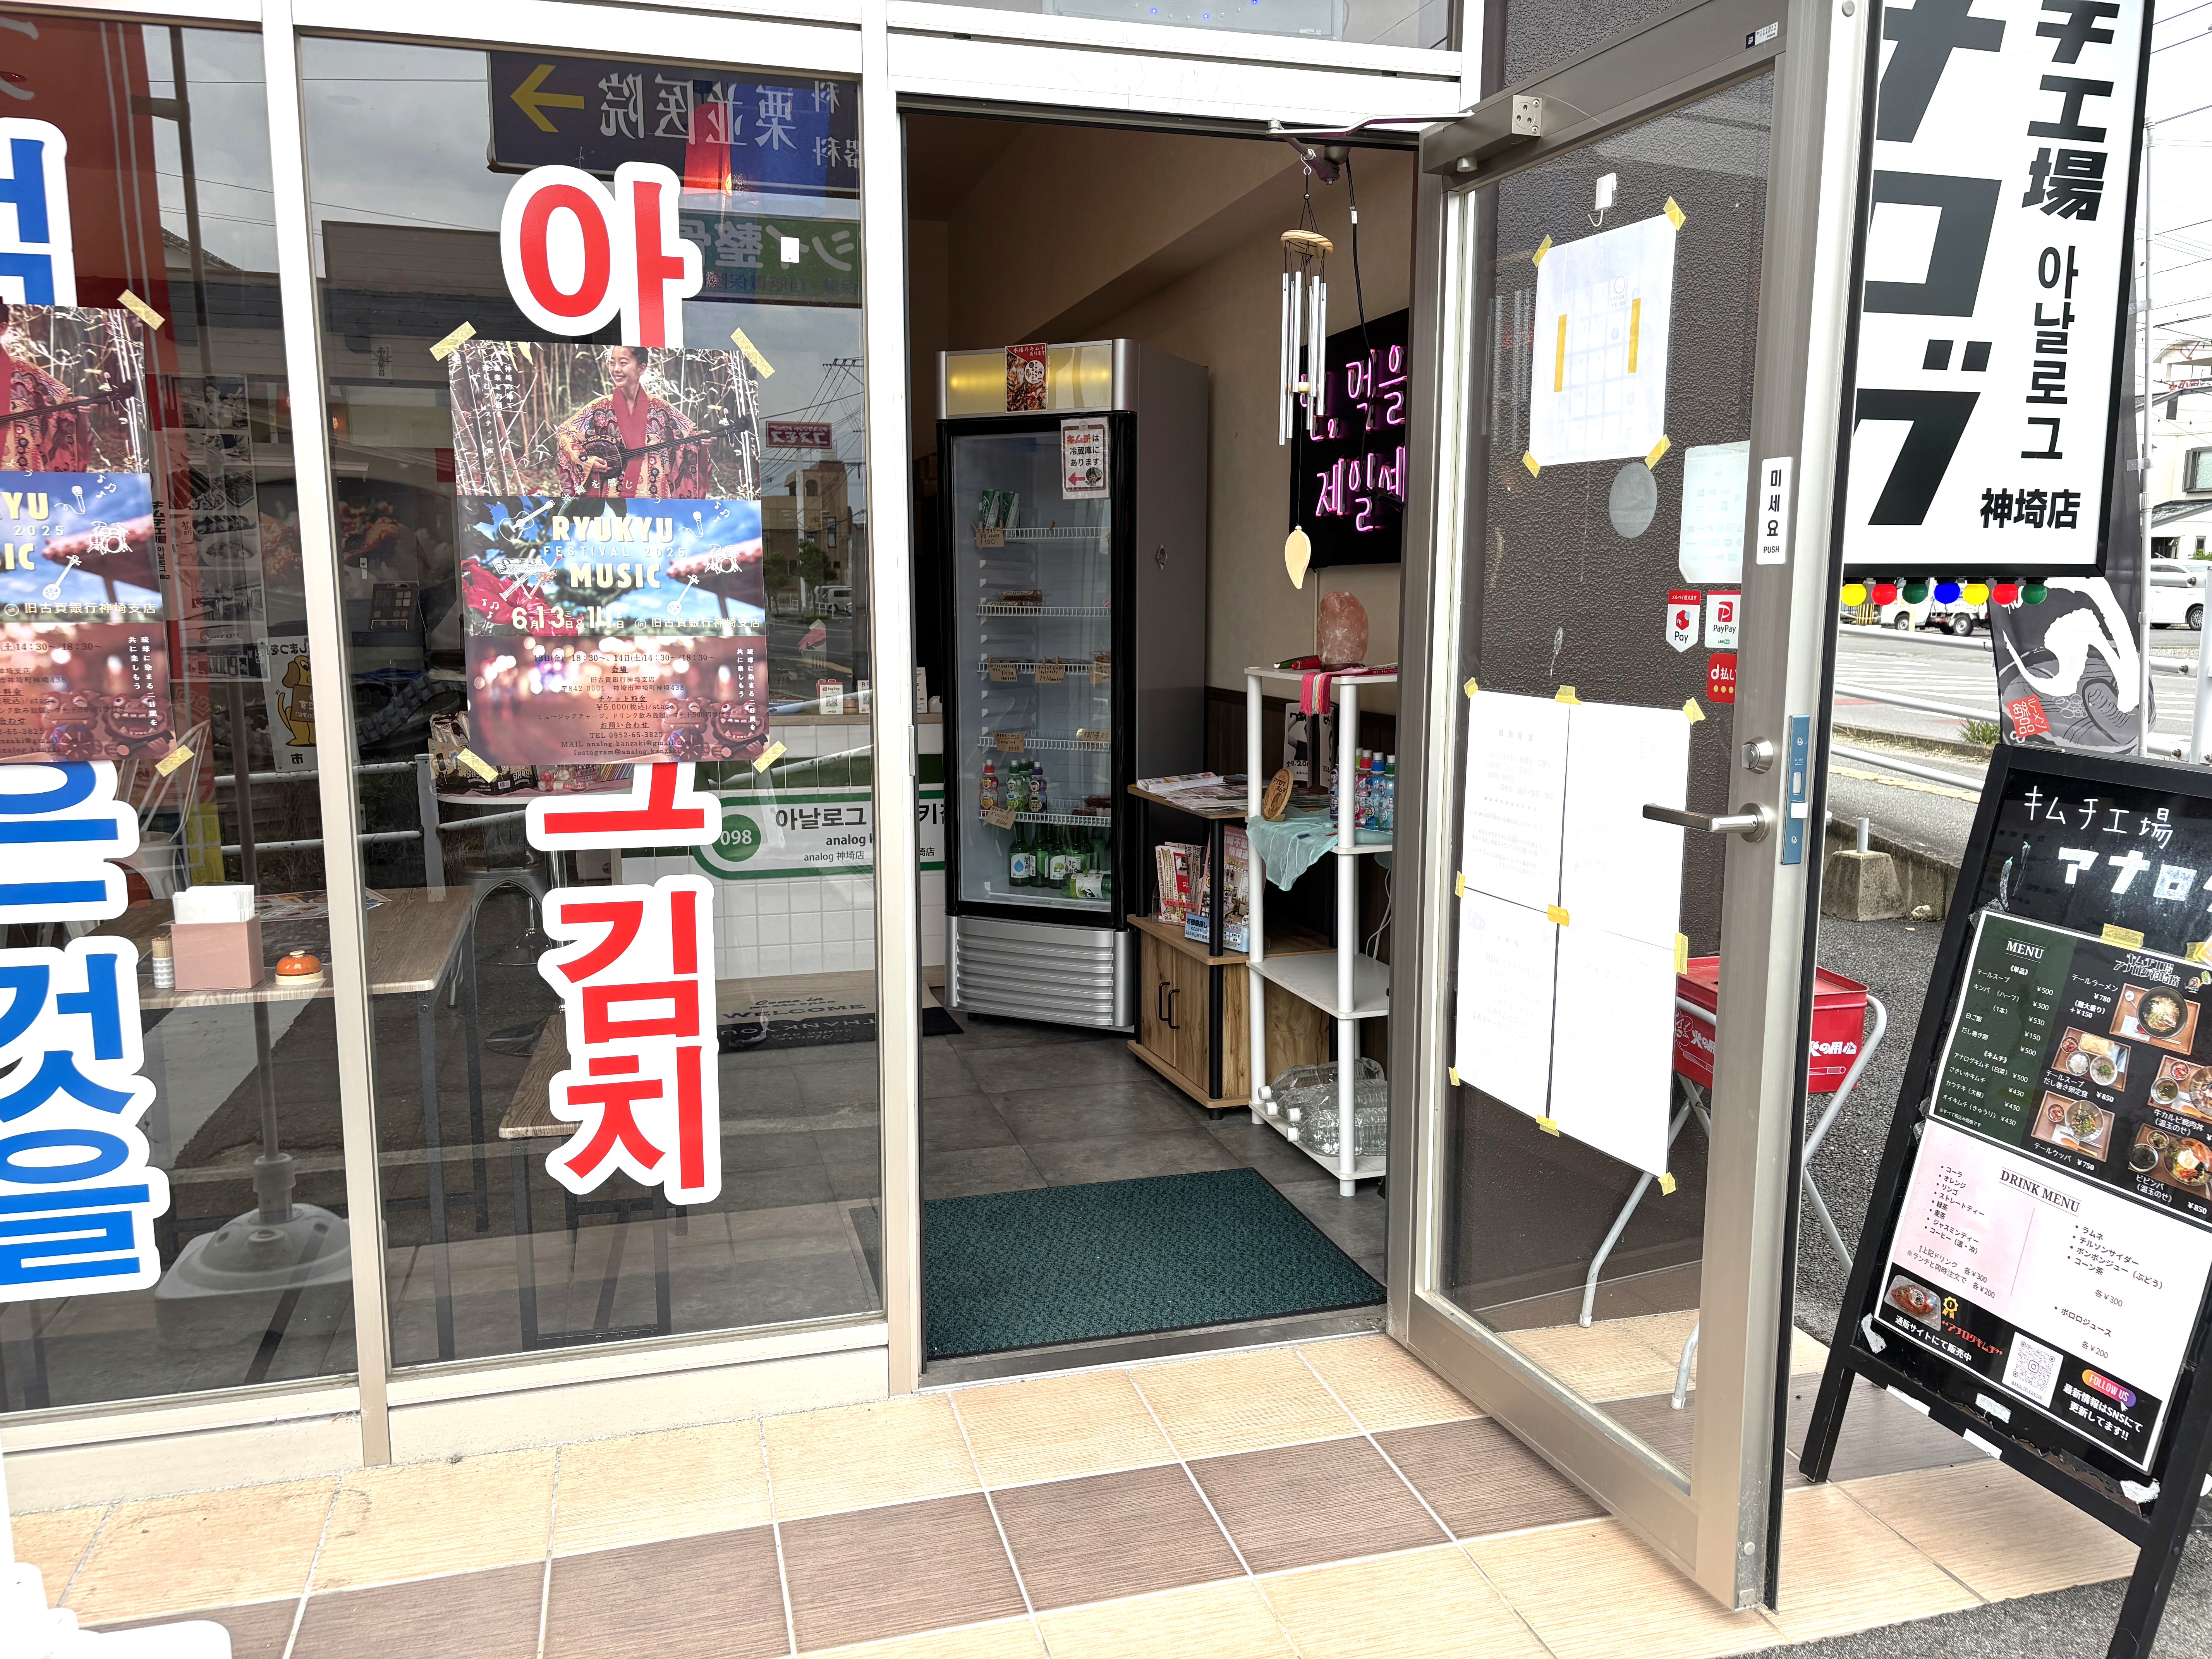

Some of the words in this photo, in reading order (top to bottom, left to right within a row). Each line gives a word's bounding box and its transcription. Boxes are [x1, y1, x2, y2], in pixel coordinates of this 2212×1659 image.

[2021, 245, 2079, 459] 아날로그
[1067, 434, 1099, 445] キムチは
[1070, 446, 1099, 455] 冷蔵庫に
[1070, 458, 1099, 467] あります
[1767, 469, 1782, 537] 미세요
[1980, 488, 2081, 529] 神埼店
[552, 515, 674, 544] RYUKYU
[543, 546, 630, 557] FESTIVAL
[644, 546, 686, 558] 2025
[1763, 545, 1780, 554] PUSH
[570, 563, 661, 589] MUSIC
[25, 602, 156, 614] 旧古賀銀行神埼支店
[651, 617, 761, 629] 旧古賀銀行神埼支店
[1713, 624, 1736, 634] PayPay
[1674, 631, 1689, 644] Pay
[128, 636, 141, 690] 共に楽しもう
[736, 648, 745, 698] 共に楽しもう
[775, 807, 867, 830] 아날로그
[2024, 785, 2174, 849] キムチ工場
[720, 829, 752, 845] 098
[826, 834, 866, 847] analog
[804, 853, 834, 862] analog
[836, 850, 865, 860] 神埼店
[2058, 847, 2212, 912] アナロ
[2006, 940, 2045, 960] MENU
[1977, 969, 2010, 982] テールスープ
[2037, 986, 2053, 996] ¥500
[2071, 974, 2119, 992] テールラーメン
[2033, 1001, 2049, 1011] ¥300
[2094, 993, 2111, 1003] ¥780
[721, 1004, 866, 1019] WELCOME
[1965, 1012, 1983, 1023] 白ご飯
[2025, 1031, 2041, 1041] ¥150
[2028, 1016, 2045, 1026] ¥530
[556, 891, 704, 1189] 김치
[1961, 1027, 1989, 1041] だし巻き卵
[2020, 1046, 2036, 1056] ¥500
[1949, 1066, 1985, 1083] さきいかキムチ
[2008, 1087, 2024, 1097] ¥430
[2012, 1073, 2028, 1083] ¥500
[2045, 1070, 2085, 1087] テールスープ
[2044, 1077, 2089, 1099] だし巻き卵定食
[2096, 1091, 2114, 1103] ¥850
[2004, 1101, 2020, 1111] ¥430
[2001, 1116, 2016, 1126] ¥430
[2034, 1142, 2072, 1162] テールクッパ
[2077, 1158, 2095, 1171] ¥750
[1946, 1166, 1963, 1178] コーラ
[1942, 1184, 1958, 1196] リンゴ
[1943, 1175, 1966, 1188] オレンジ
[2000, 1170, 2040, 1195] DRINK
[2041, 1190, 2081, 1213] MENU
[1936, 1200, 1948, 1211] 緑茶
[1939, 1192, 1985, 1216] ストレートティー
[2187, 1201, 2207, 1215] ¥850
[1933, 1219, 1979, 1243] ジャスミンティー
[2082, 1226, 2104, 1241] ラムネ
[2074, 1257, 2104, 1276] コーン茶
[2095, 1289, 2123, 1307] 各¥300
[1895, 1314, 1973, 1363] 通販サイトにて販売中
[2081, 1341, 2109, 1359] 各¥200
[2089, 1374, 2119, 1396] FOLLOW
[2118, 1389, 2130, 1402] US
[2062, 1382, 2143, 1433] 最新情報はSNSにて
